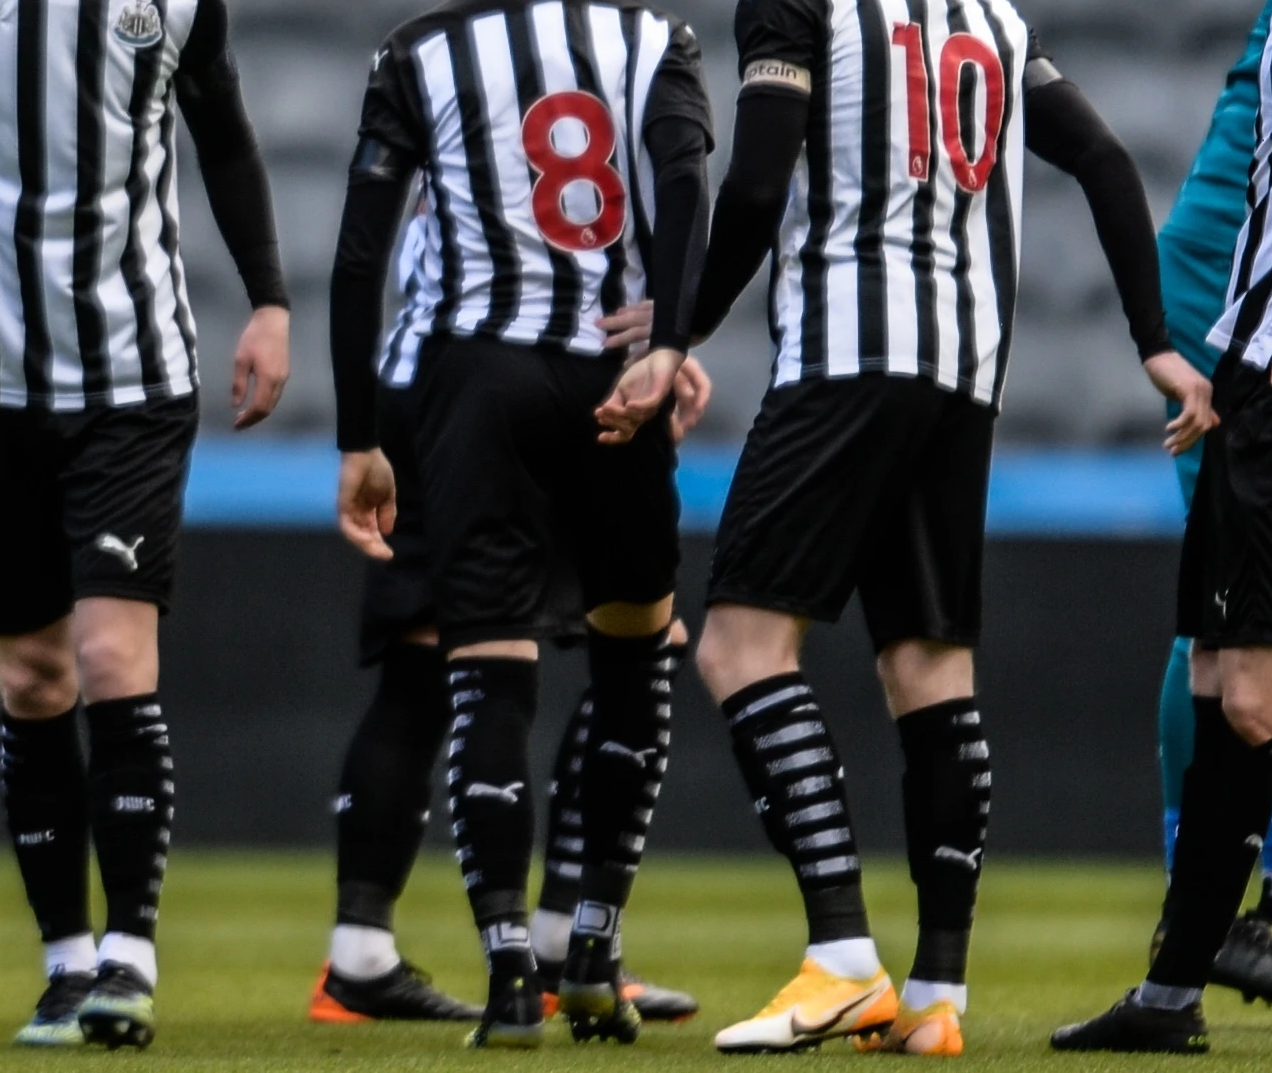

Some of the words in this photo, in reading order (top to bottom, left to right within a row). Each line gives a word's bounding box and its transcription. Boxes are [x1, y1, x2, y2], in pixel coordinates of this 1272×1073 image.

[747, 63, 797, 80] ptain
[892, 22, 1006, 193] 10
[521, 90, 627, 252] 8
